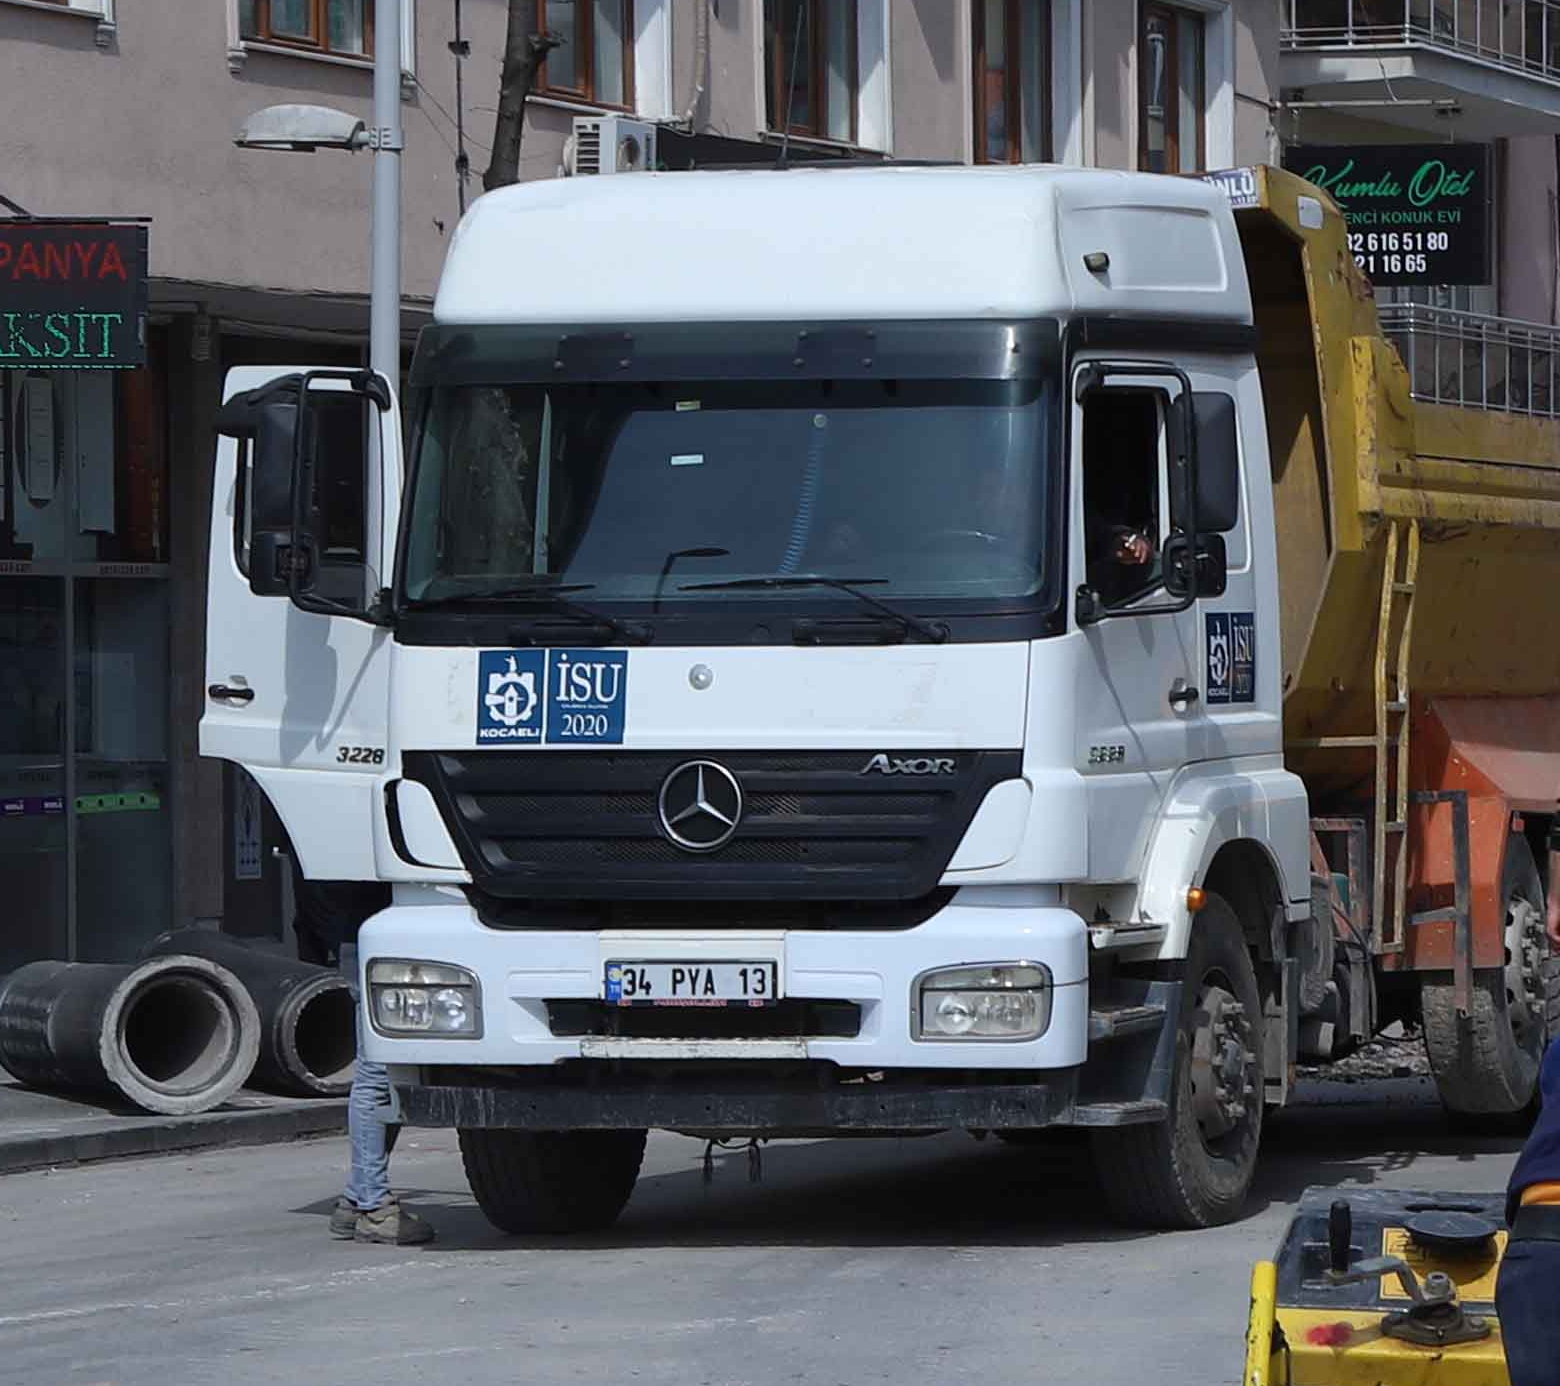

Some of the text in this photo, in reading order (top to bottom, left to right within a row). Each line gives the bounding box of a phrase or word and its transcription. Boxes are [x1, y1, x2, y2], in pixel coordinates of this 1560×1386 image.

[1304, 160, 1475, 208] Kumlu Otel
[1382, 211, 1433, 224] KONUK
[1438, 209, 1461, 223] EVİ
[1368, 233, 1399, 251] 616
[1403, 232, 1422, 250] 51
[1427, 232, 1448, 250] 80
[1383, 255, 1401, 273] 16
[1405, 254, 1427, 273] 65
[555, 653, 623, 702] İSU
[561, 714, 608, 737] 2020
[336, 746, 385, 764] 3228
[623, 967, 766, 996] 34 PYA 13
